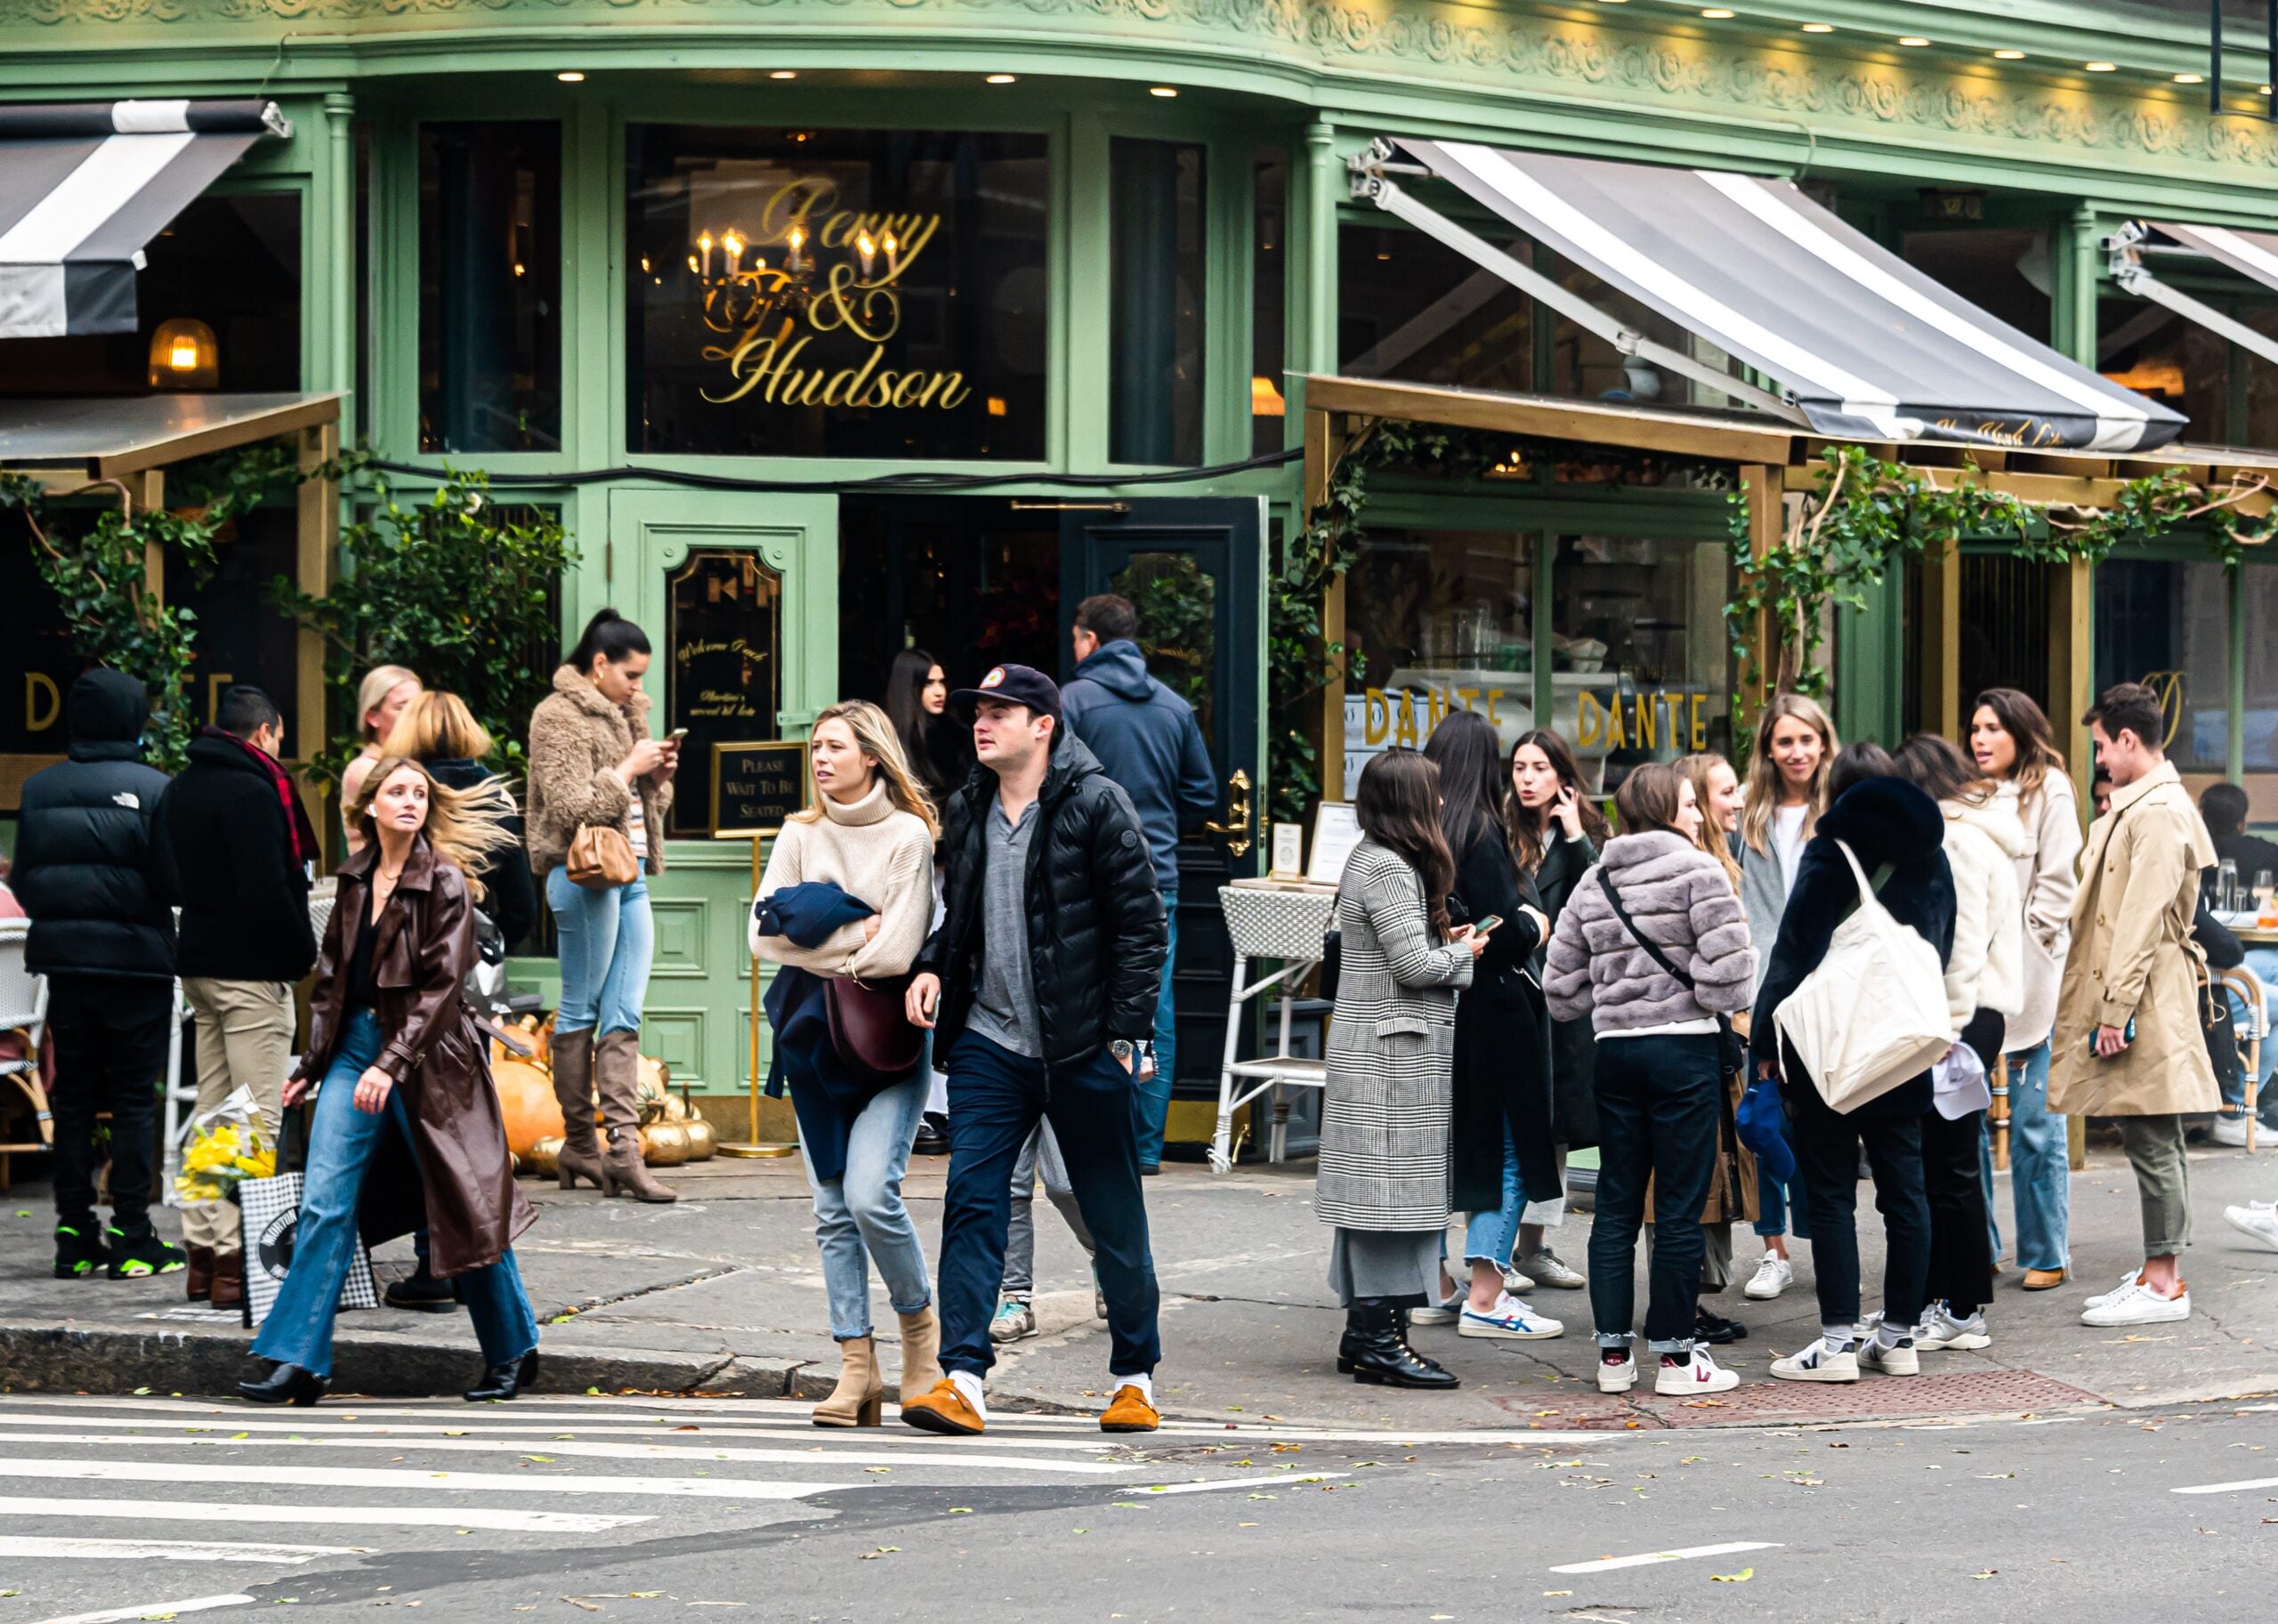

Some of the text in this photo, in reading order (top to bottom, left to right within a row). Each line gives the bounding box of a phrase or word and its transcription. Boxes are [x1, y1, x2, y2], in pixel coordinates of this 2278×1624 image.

[807, 263, 901, 342] &
[699, 335, 972, 409] Hudson
[1578, 691, 1707, 750] DANTE
[260, 1208, 298, 1248] MORTON
